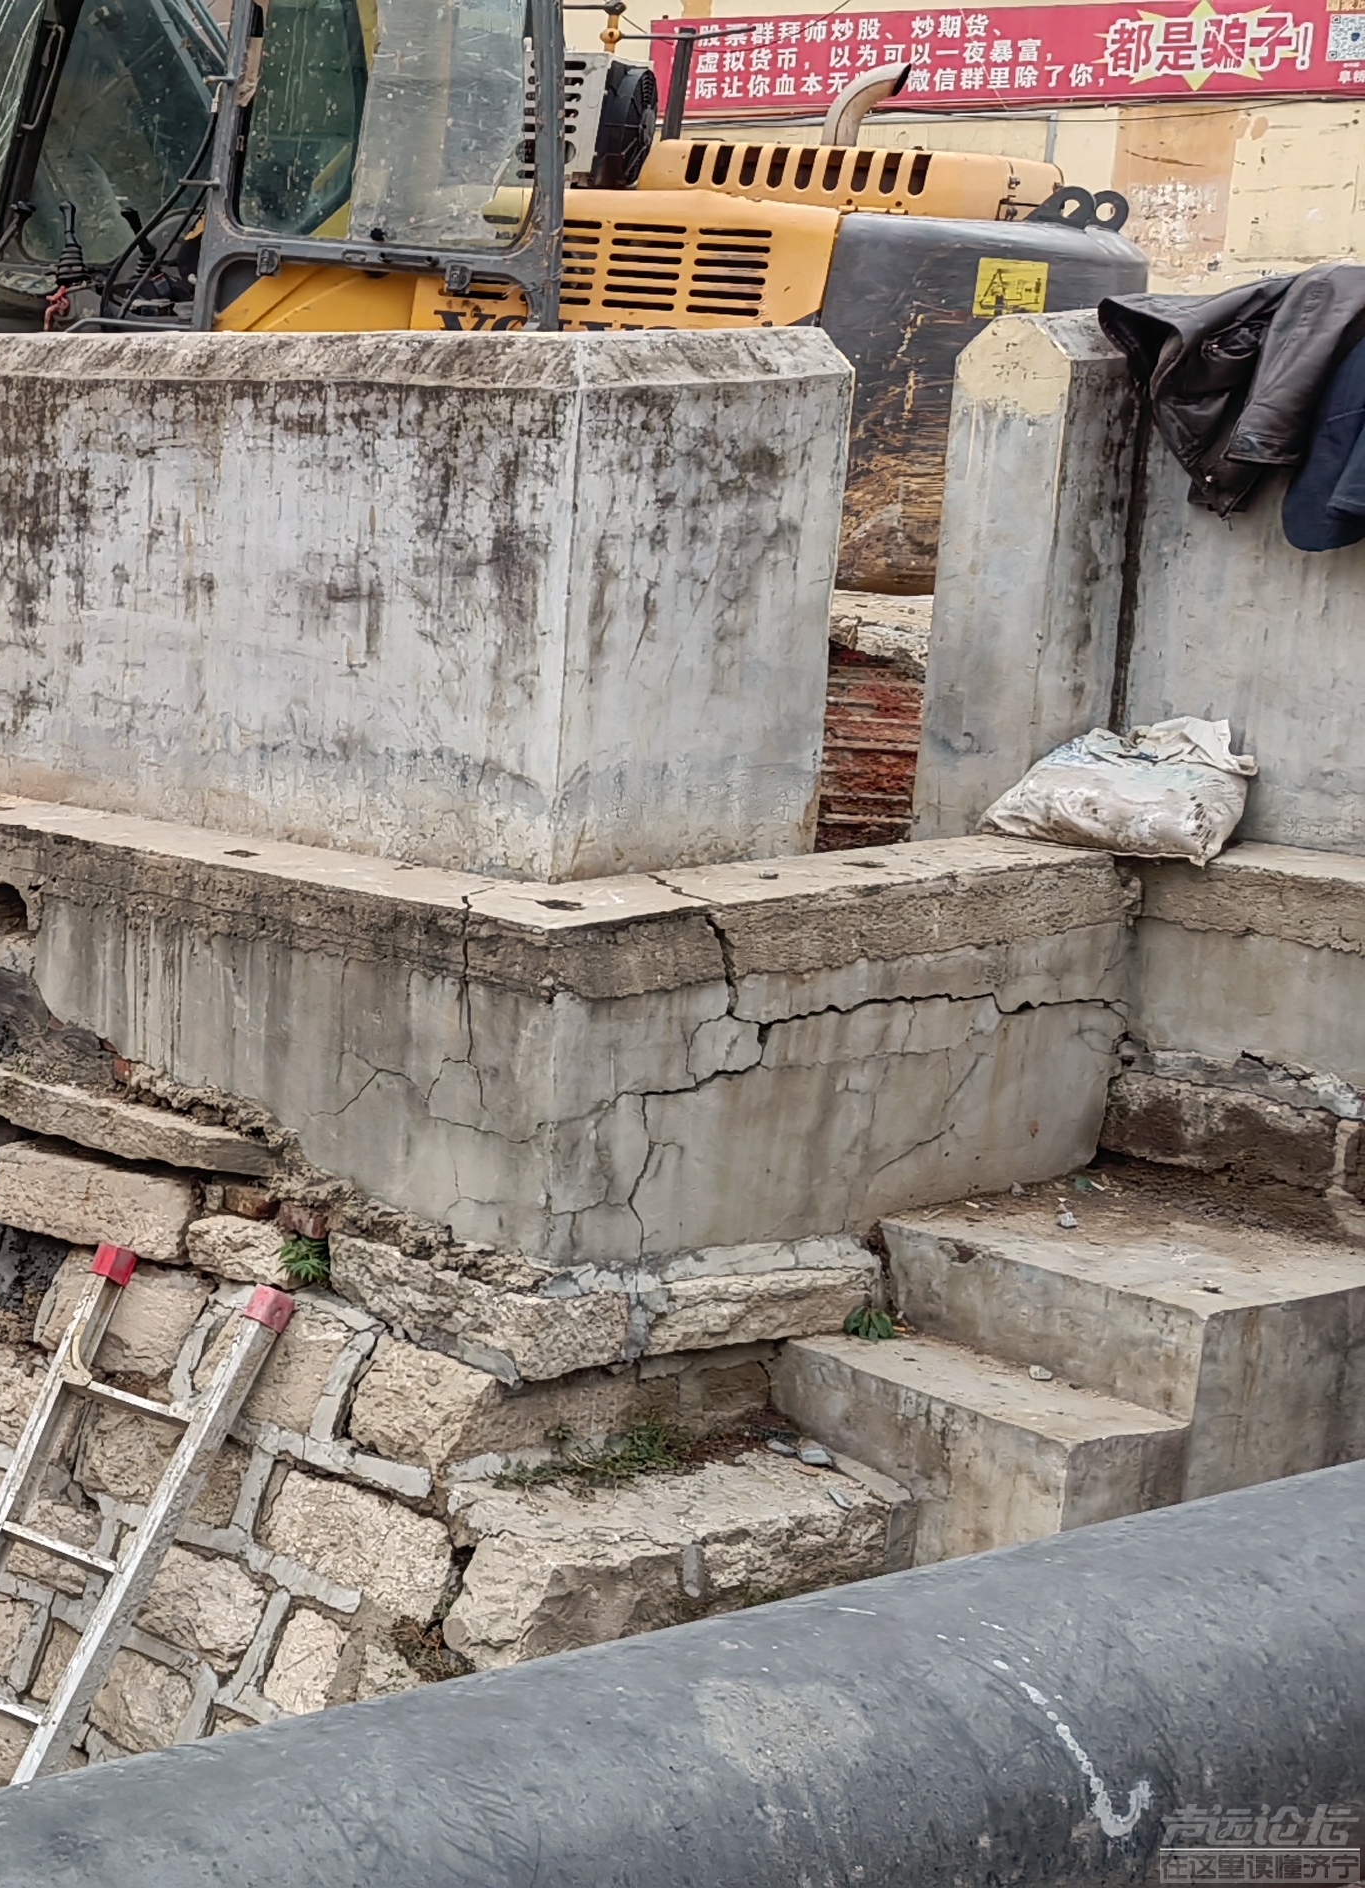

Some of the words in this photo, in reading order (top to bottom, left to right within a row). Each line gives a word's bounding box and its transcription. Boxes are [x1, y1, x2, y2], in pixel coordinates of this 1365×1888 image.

[673, 13, 1002, 47] 股票群拜师炒股、炒期货、
[671, 38, 1053, 74] 虚拟货币，以为可以一夜暴富，
